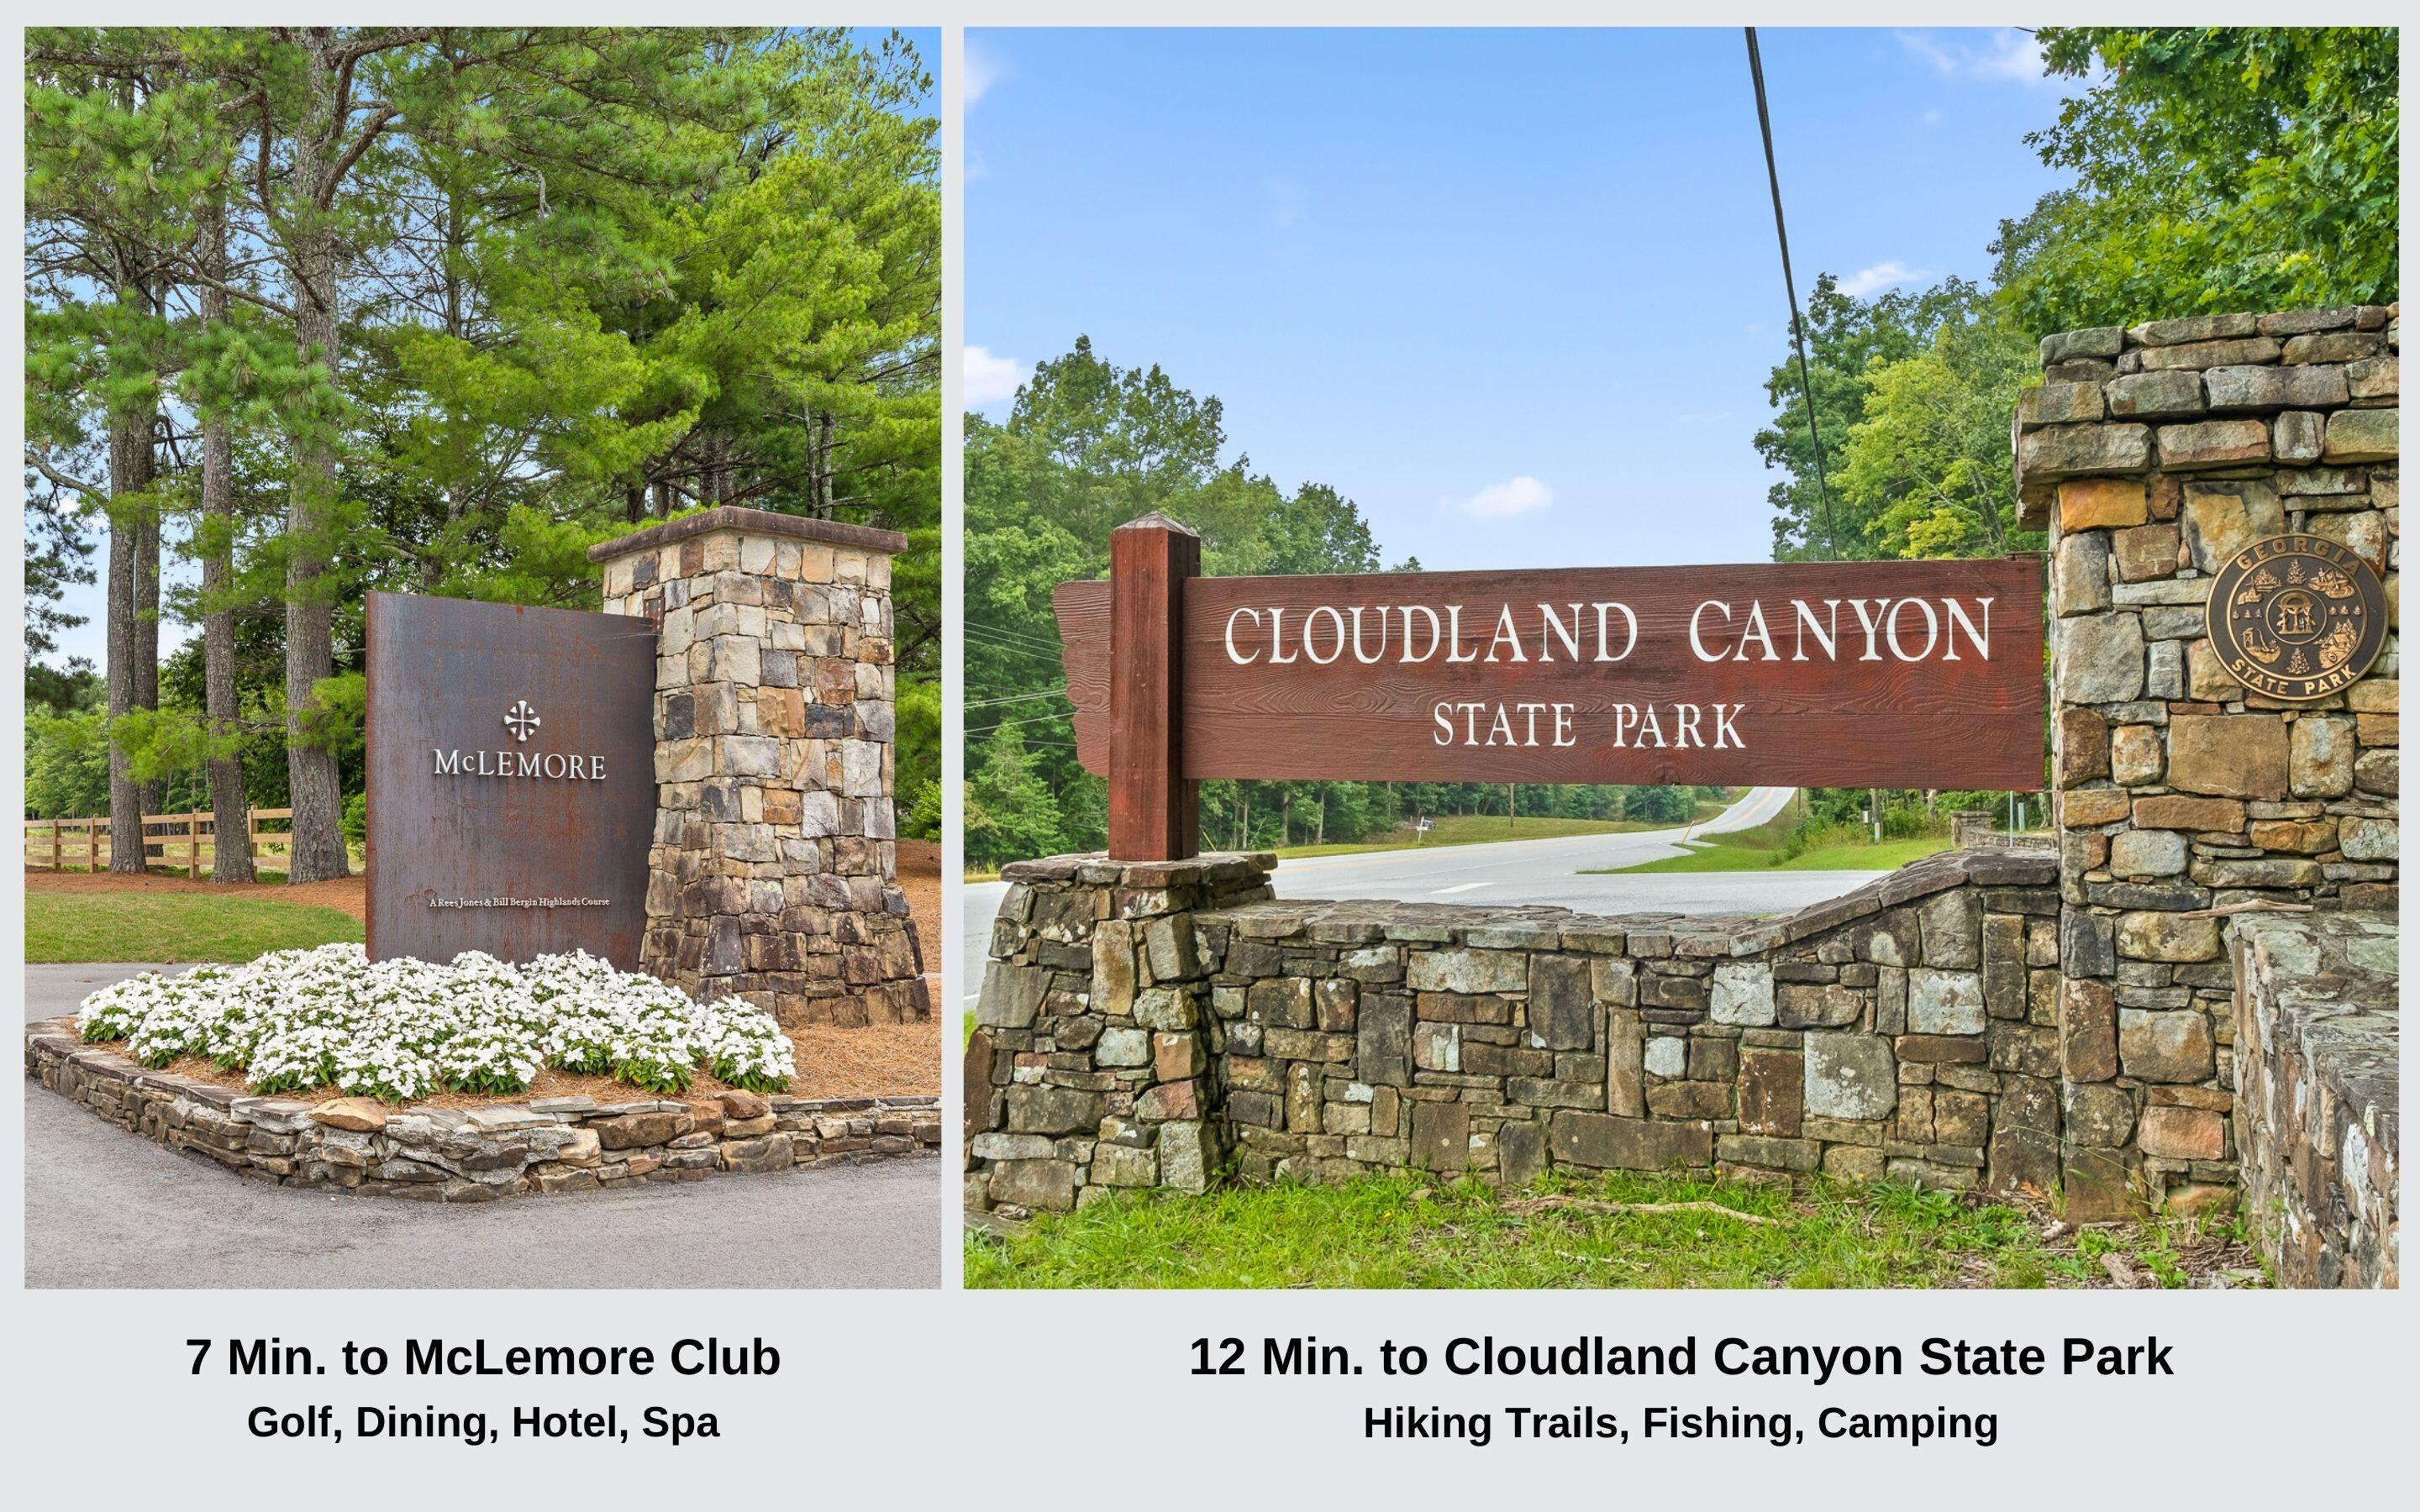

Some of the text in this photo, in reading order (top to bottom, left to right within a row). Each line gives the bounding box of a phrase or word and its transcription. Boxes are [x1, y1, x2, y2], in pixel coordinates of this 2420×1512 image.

[2236, 536, 2362, 576] GEORGIA
[1224, 596, 1995, 665] CLOUDLAND CANYON
[2231, 658, 2358, 696] STATE PARK
[1433, 701, 1747, 750] STATE PARK
[433, 748, 608, 780] McLEMORE
[429, 896, 610, 909] A Rees Jones & Bill Bergin Highlands Course
